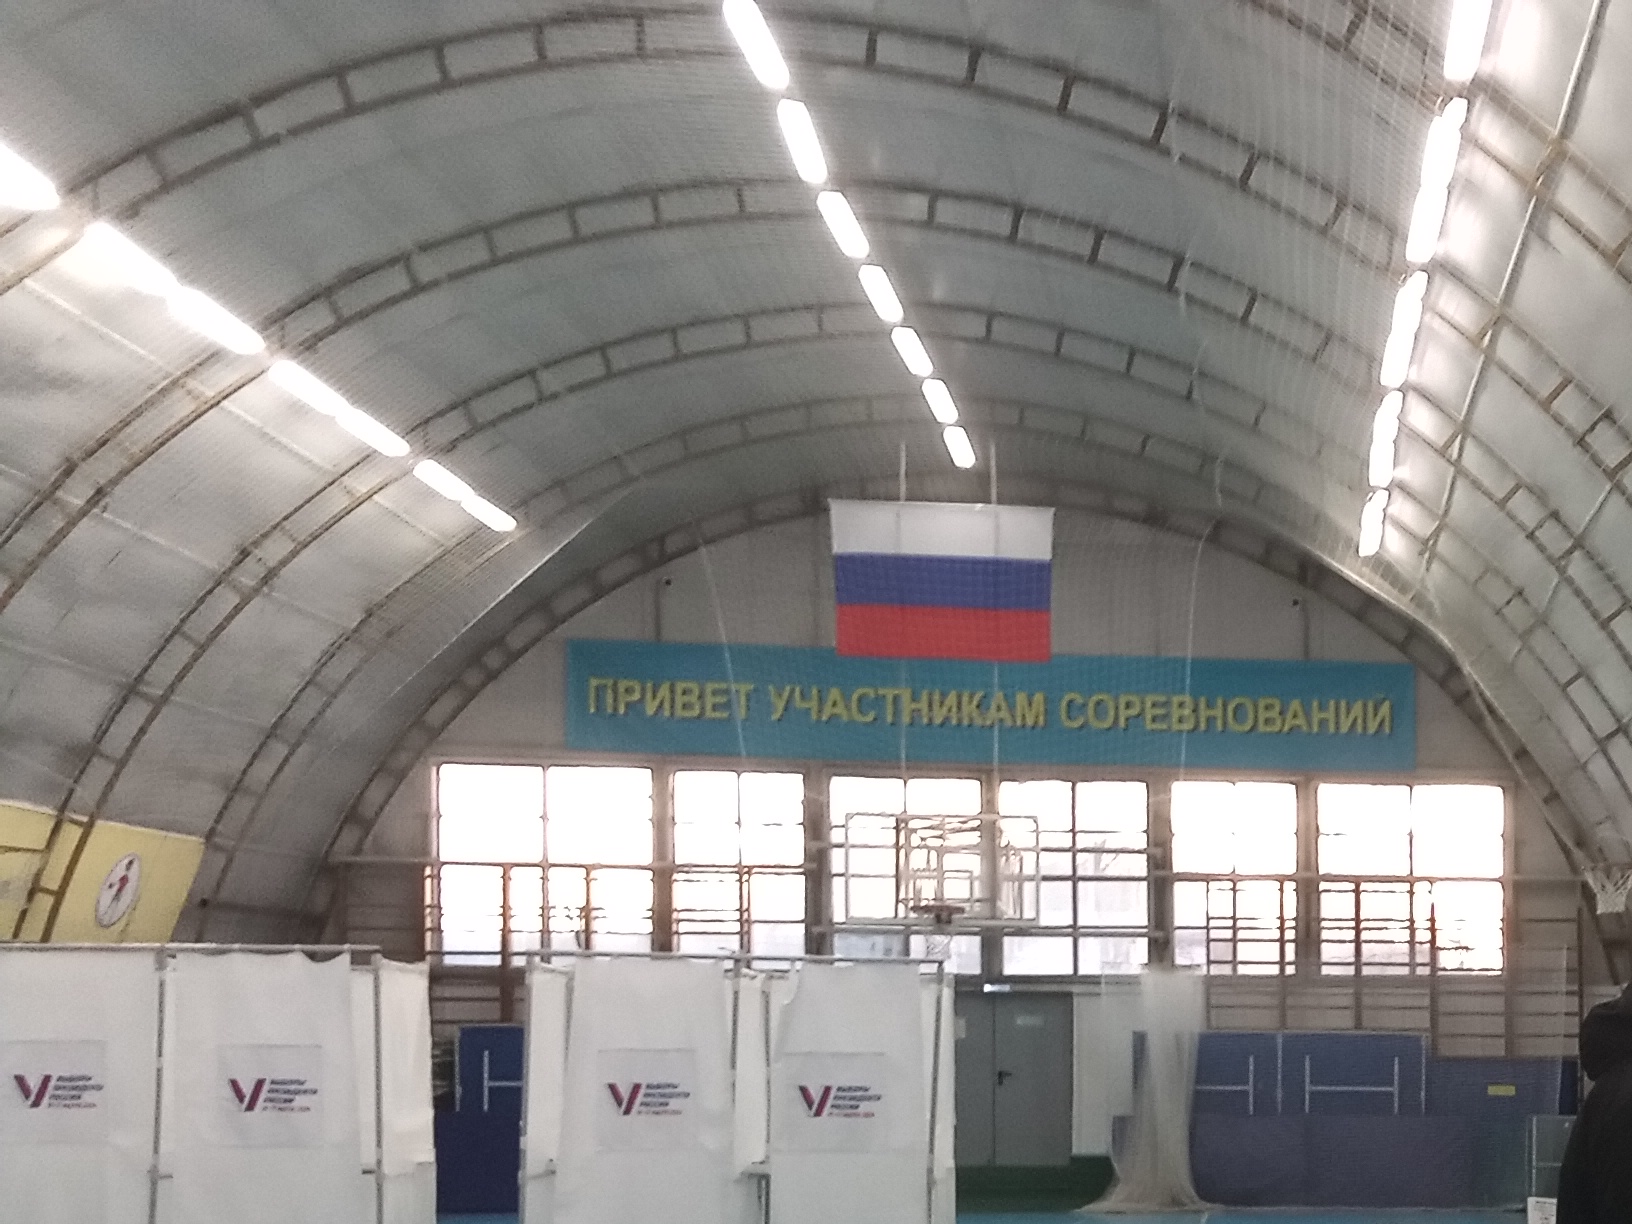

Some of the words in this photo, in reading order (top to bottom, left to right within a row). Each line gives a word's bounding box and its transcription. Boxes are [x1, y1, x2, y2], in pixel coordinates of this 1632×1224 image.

[588, 675, 754, 720] ПРИВЕТ
[768, 682, 1049, 729] УЧАСТНИКАМ
[1059, 690, 1393, 735] СОРЕВНОВАНИЙ
